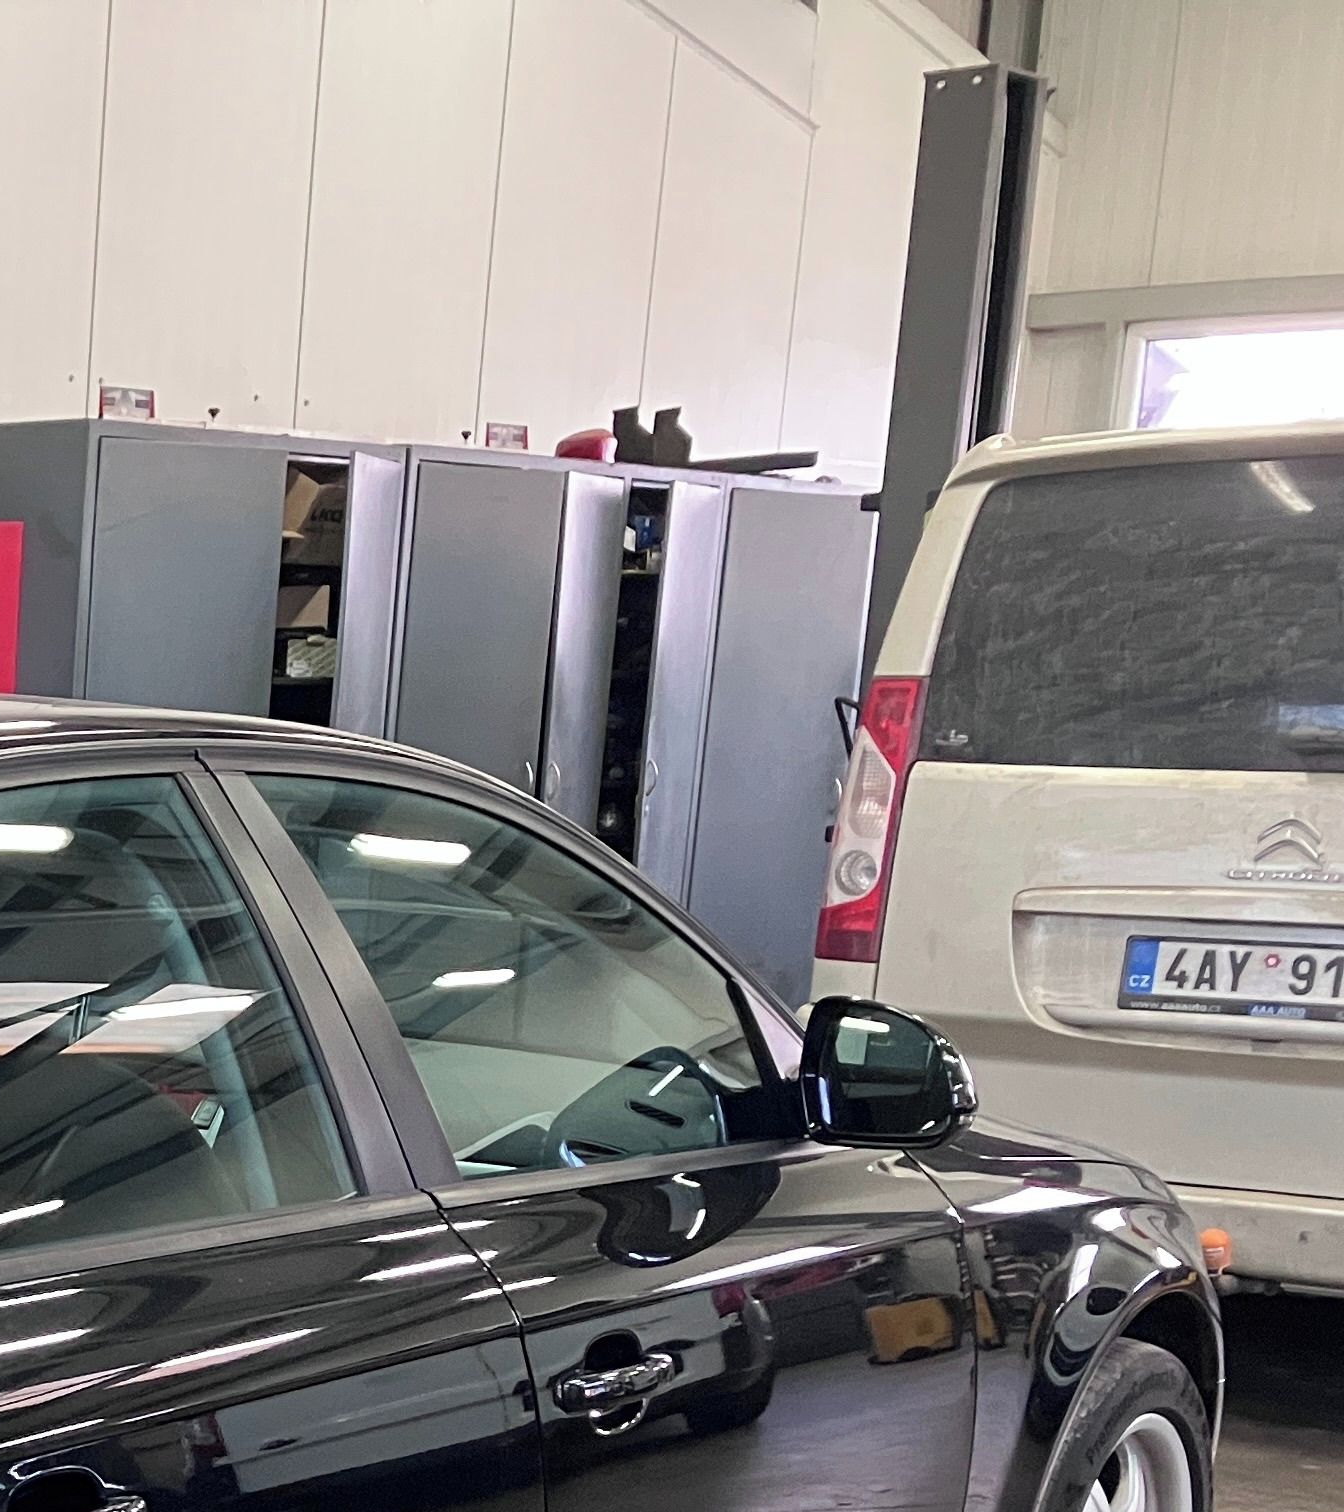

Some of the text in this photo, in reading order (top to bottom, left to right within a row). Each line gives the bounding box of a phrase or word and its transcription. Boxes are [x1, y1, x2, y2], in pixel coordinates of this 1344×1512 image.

[1164, 948, 1344, 998] 4AY 91
[1128, 974, 1152, 988] CZ
[1250, 1005, 1307, 1018] AAA AUTO
